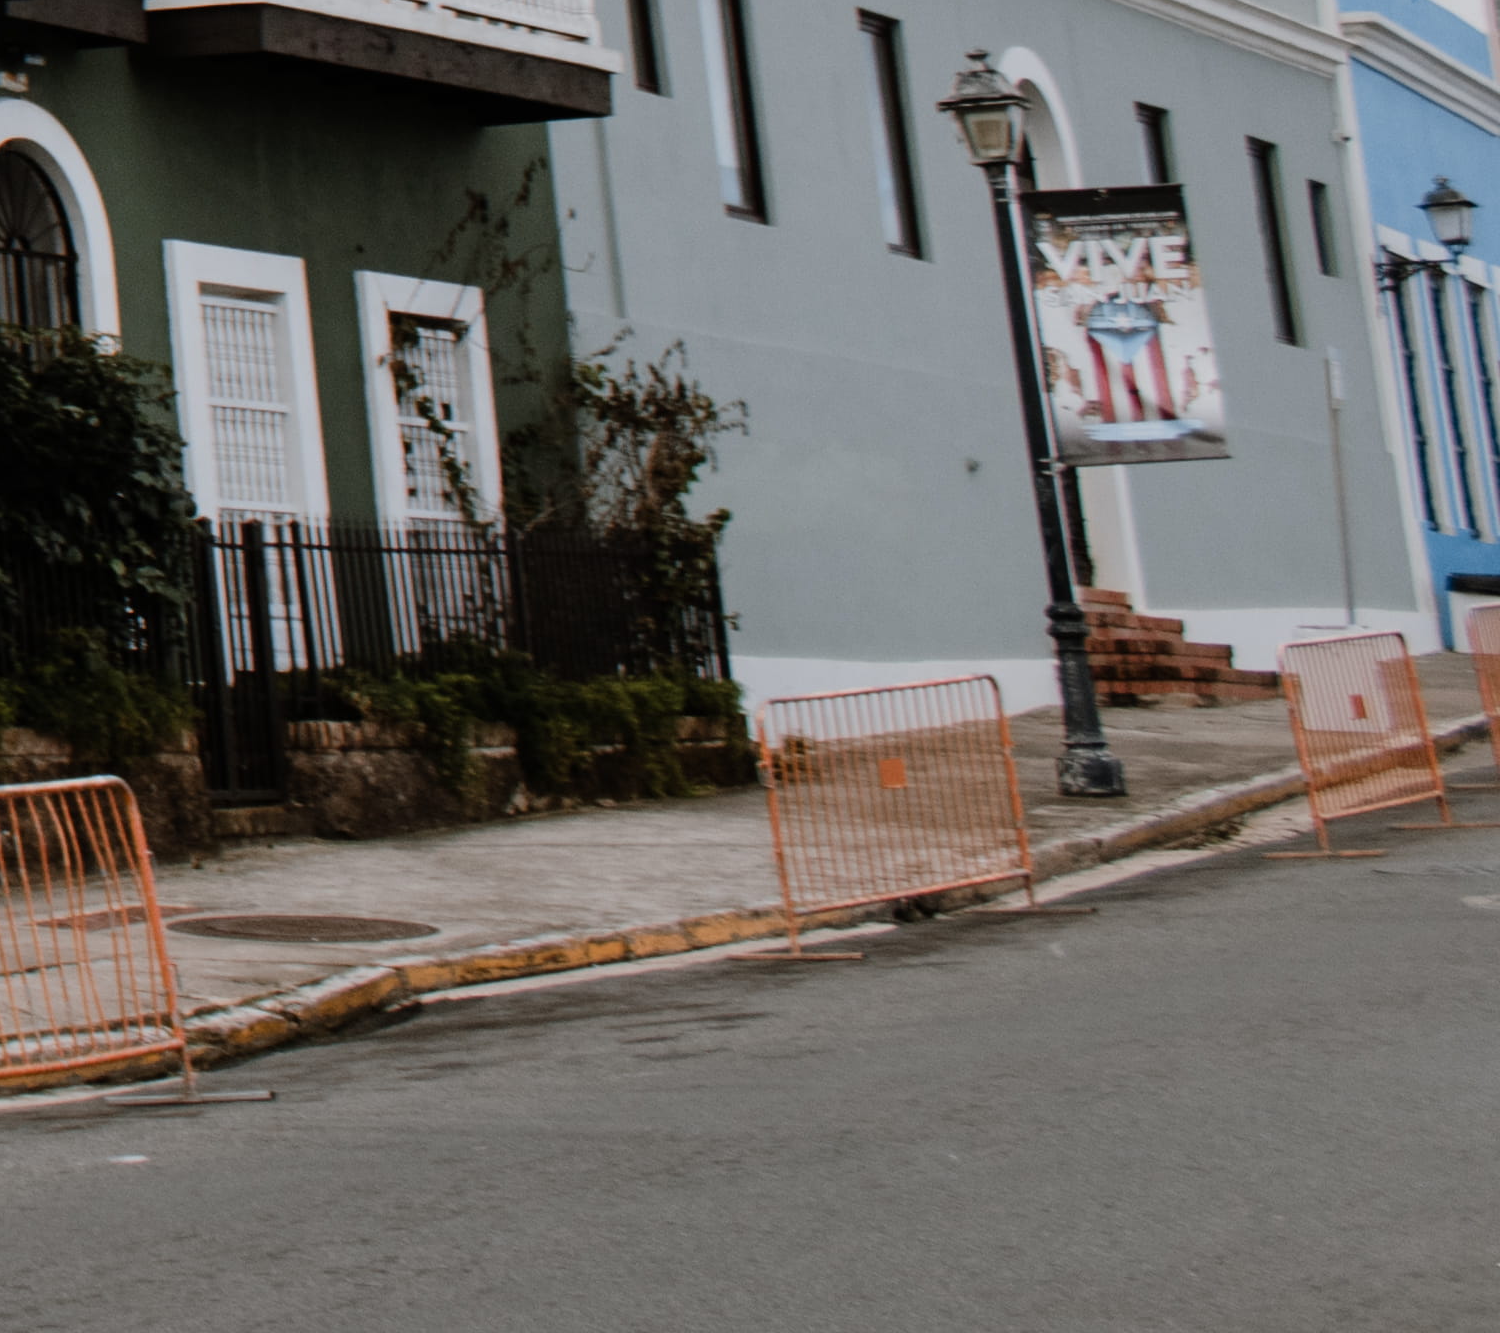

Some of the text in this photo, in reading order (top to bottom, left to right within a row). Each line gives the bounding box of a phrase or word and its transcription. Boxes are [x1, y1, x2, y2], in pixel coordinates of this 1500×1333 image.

[1035, 236, 1190, 281] VIVE
[1046, 281, 1192, 308] SAN JUAN
